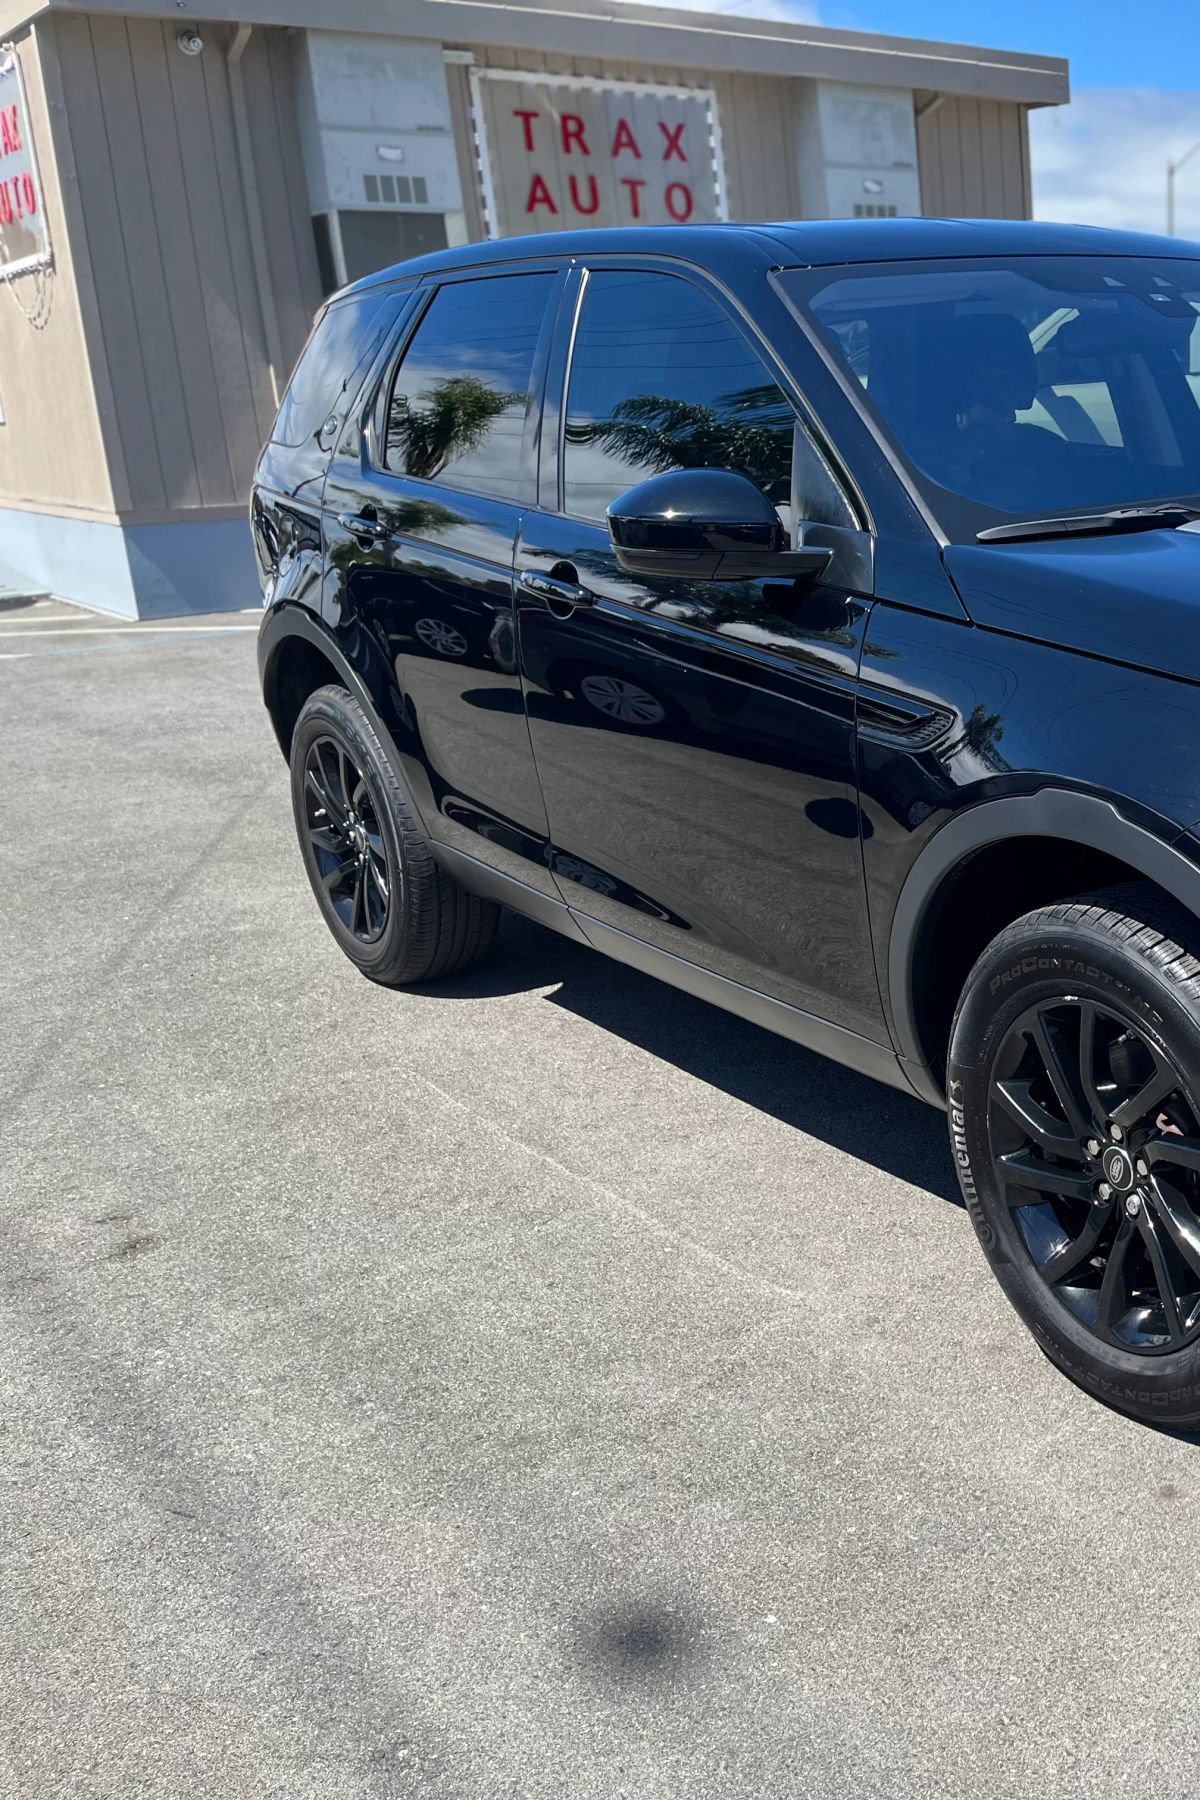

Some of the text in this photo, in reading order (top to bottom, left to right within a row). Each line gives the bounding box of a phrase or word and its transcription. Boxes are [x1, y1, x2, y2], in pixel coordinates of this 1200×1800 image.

[513, 111, 688, 162] TRAX
[525, 174, 694, 223] AUTO
[950, 1097, 998, 1251] Continental
